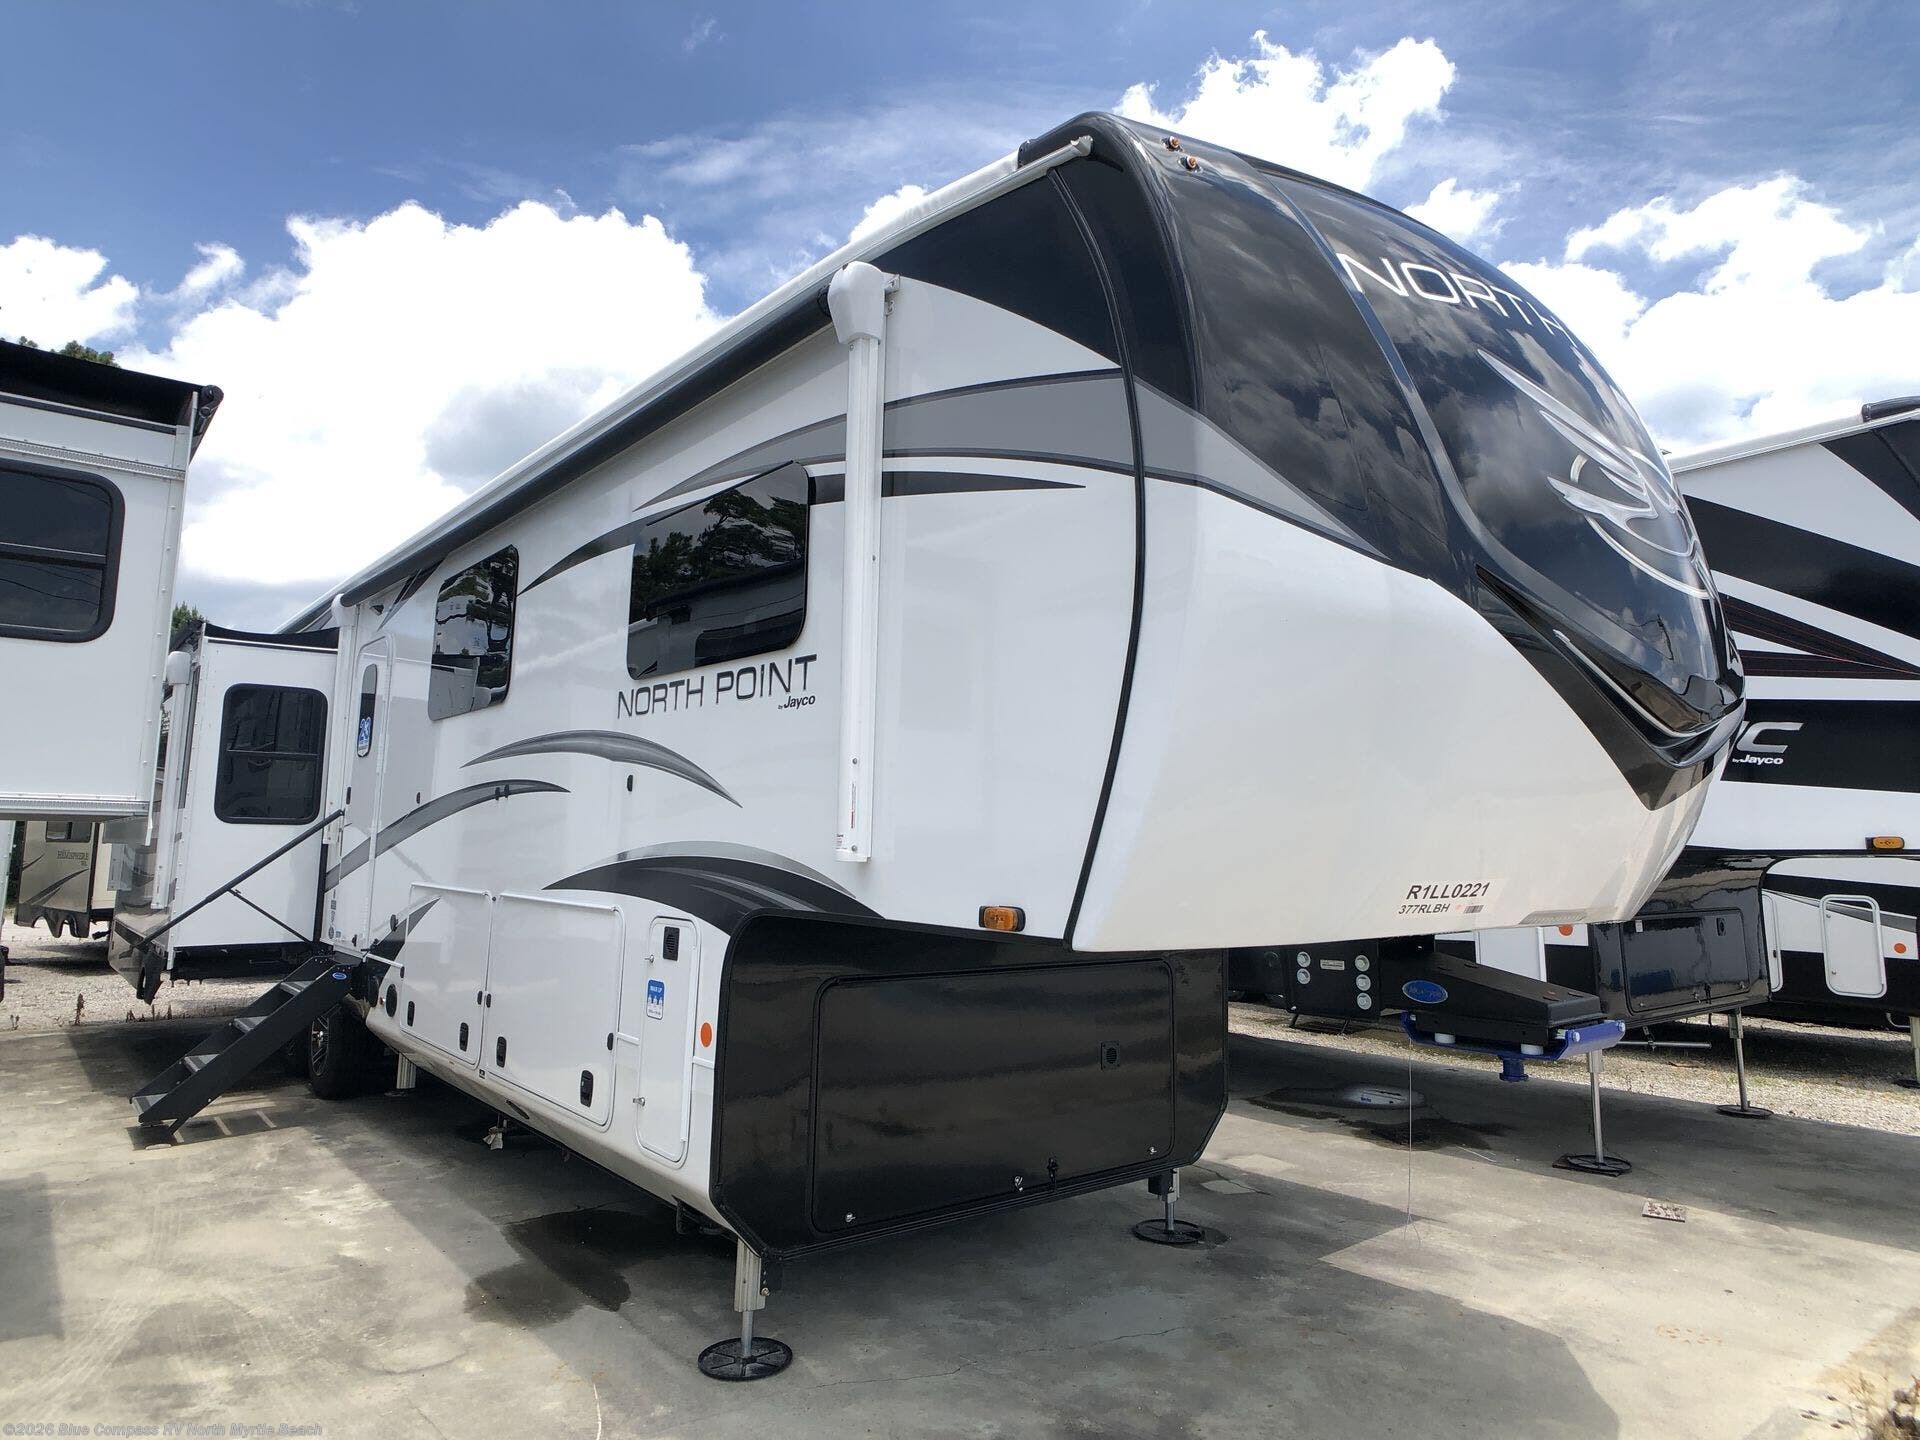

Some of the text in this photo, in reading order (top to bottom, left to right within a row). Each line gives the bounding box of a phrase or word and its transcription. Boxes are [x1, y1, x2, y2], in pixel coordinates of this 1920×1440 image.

[1335, 252, 1578, 348] NORTH
[617, 654, 818, 719] NORTH POINT
[783, 694, 816, 710] Jayco
[1740, 754, 1784, 766] Jayco
[1406, 882, 1491, 900] R1LL0221
[1398, 903, 1451, 915] 377RLBH
